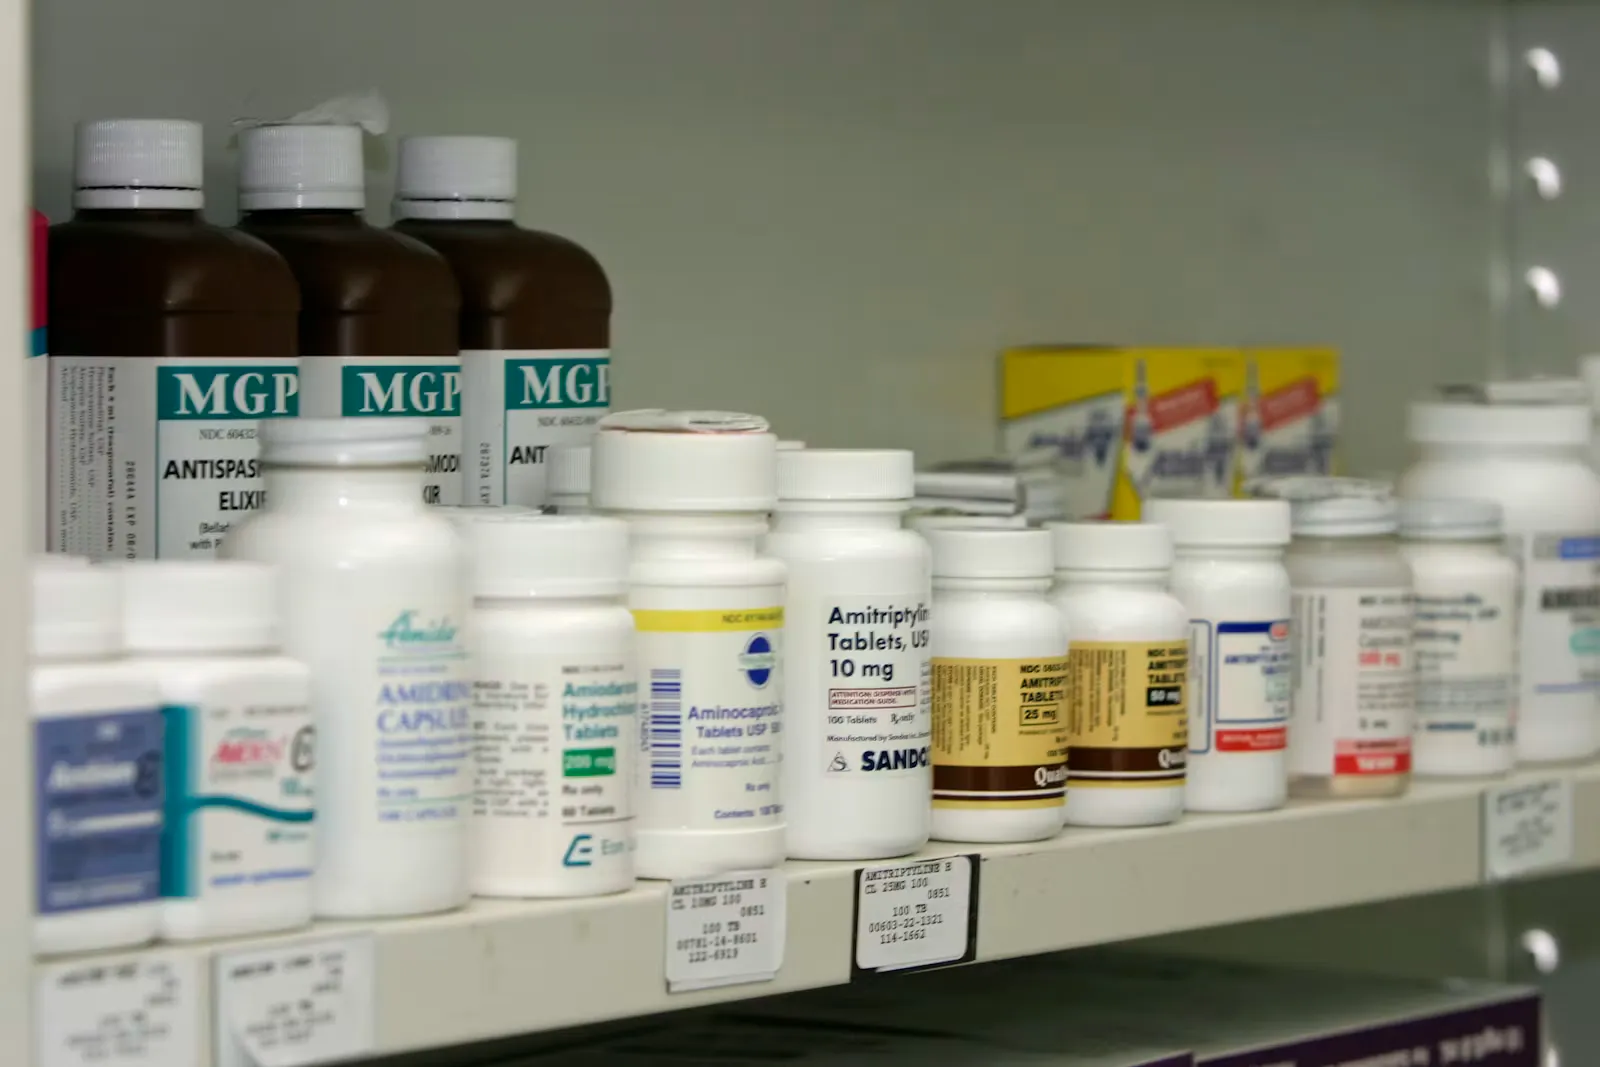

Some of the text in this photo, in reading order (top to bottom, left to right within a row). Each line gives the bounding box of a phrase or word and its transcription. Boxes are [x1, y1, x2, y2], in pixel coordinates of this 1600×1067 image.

[173, 373, 299, 415] MGP
[163, 459, 261, 479] ANTISPAS
[827, 631, 908, 652] Tablets,
[830, 659, 894, 682] 10 mg
[828, 716, 844, 725] 100
[846, 715, 878, 725] Tablets
[1024, 709, 1057, 721] 25 mg
[696, 725, 743, 738] Tablets
[827, 734, 877, 742] Manufactured
[881, 880, 906, 893] 25MG
[911, 877, 928, 889] 100
[927, 887, 951, 900] 0851
[892, 903, 928, 917] 100 TB
